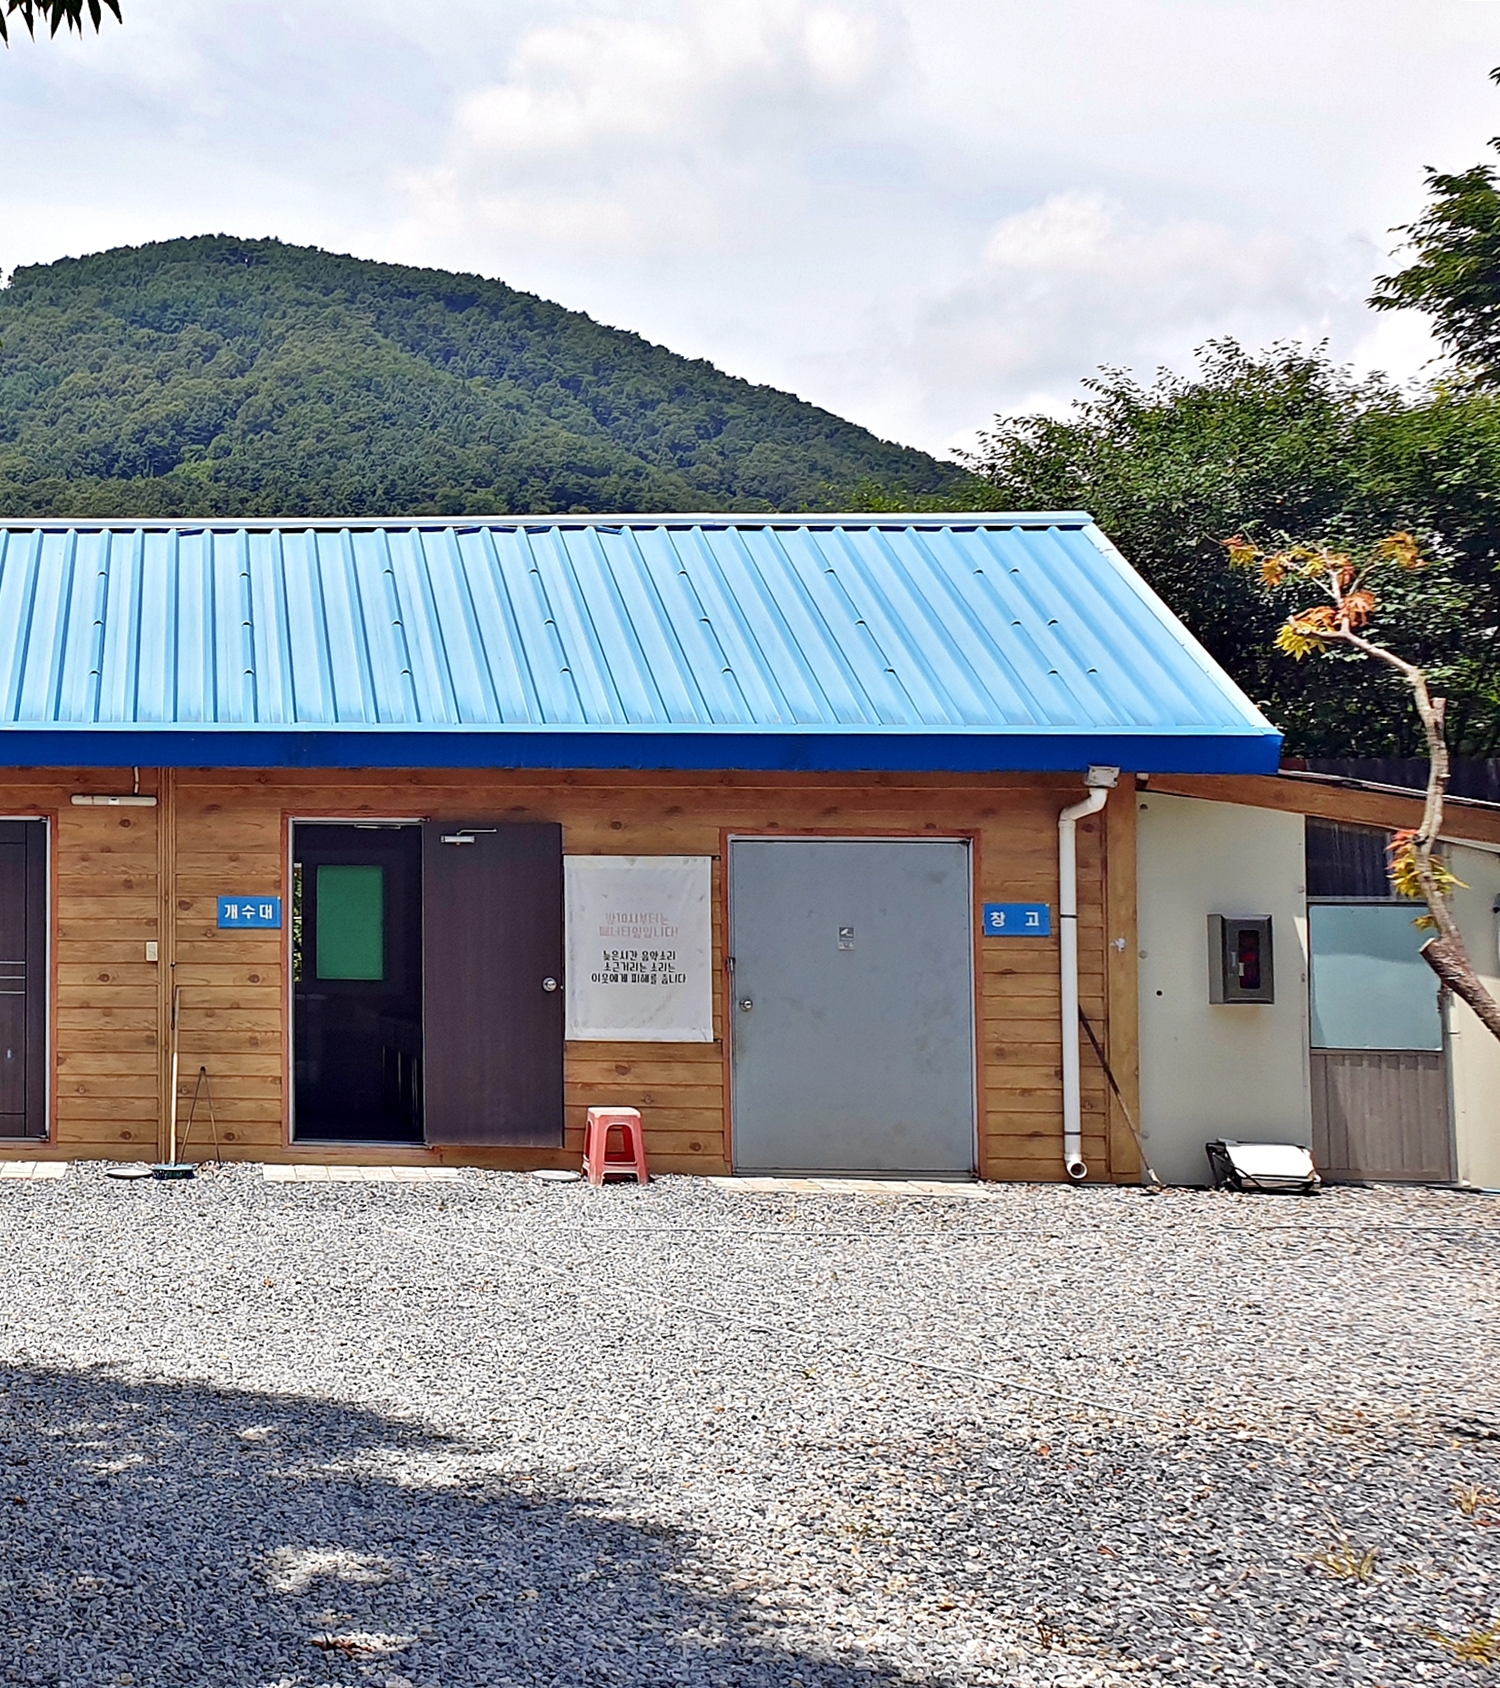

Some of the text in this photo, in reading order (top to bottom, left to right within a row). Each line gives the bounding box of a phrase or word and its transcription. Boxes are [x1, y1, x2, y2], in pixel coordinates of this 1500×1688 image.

[224, 904, 273, 919] 개수대
[603, 950, 676, 961] 늦은시간 음악소리
[603, 962, 676, 973] 소근거리는 소리는
[591, 973, 628, 984] 이웃에게
[631, 973, 657, 985] 피해를
